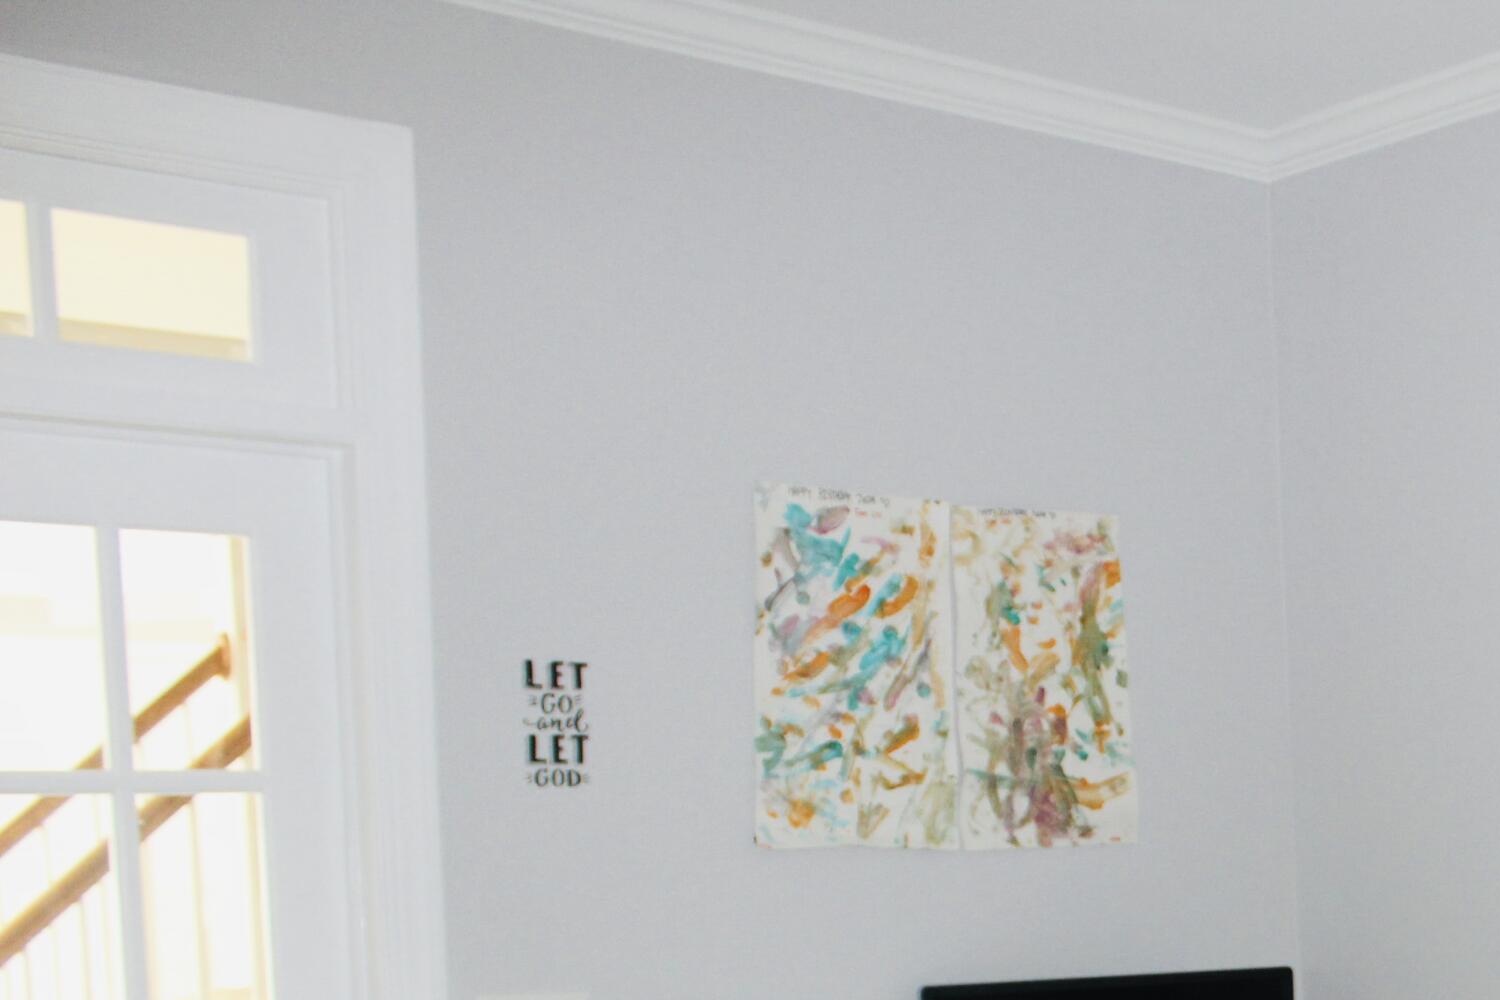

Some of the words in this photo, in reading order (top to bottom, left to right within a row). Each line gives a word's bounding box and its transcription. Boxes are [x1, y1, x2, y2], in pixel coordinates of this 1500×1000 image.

[524, 659, 588, 689] LET
[540, 692, 574, 715] GO
[523, 709, 588, 733] and
[528, 734, 589, 764] LET
[534, 768, 583, 787] GOD
